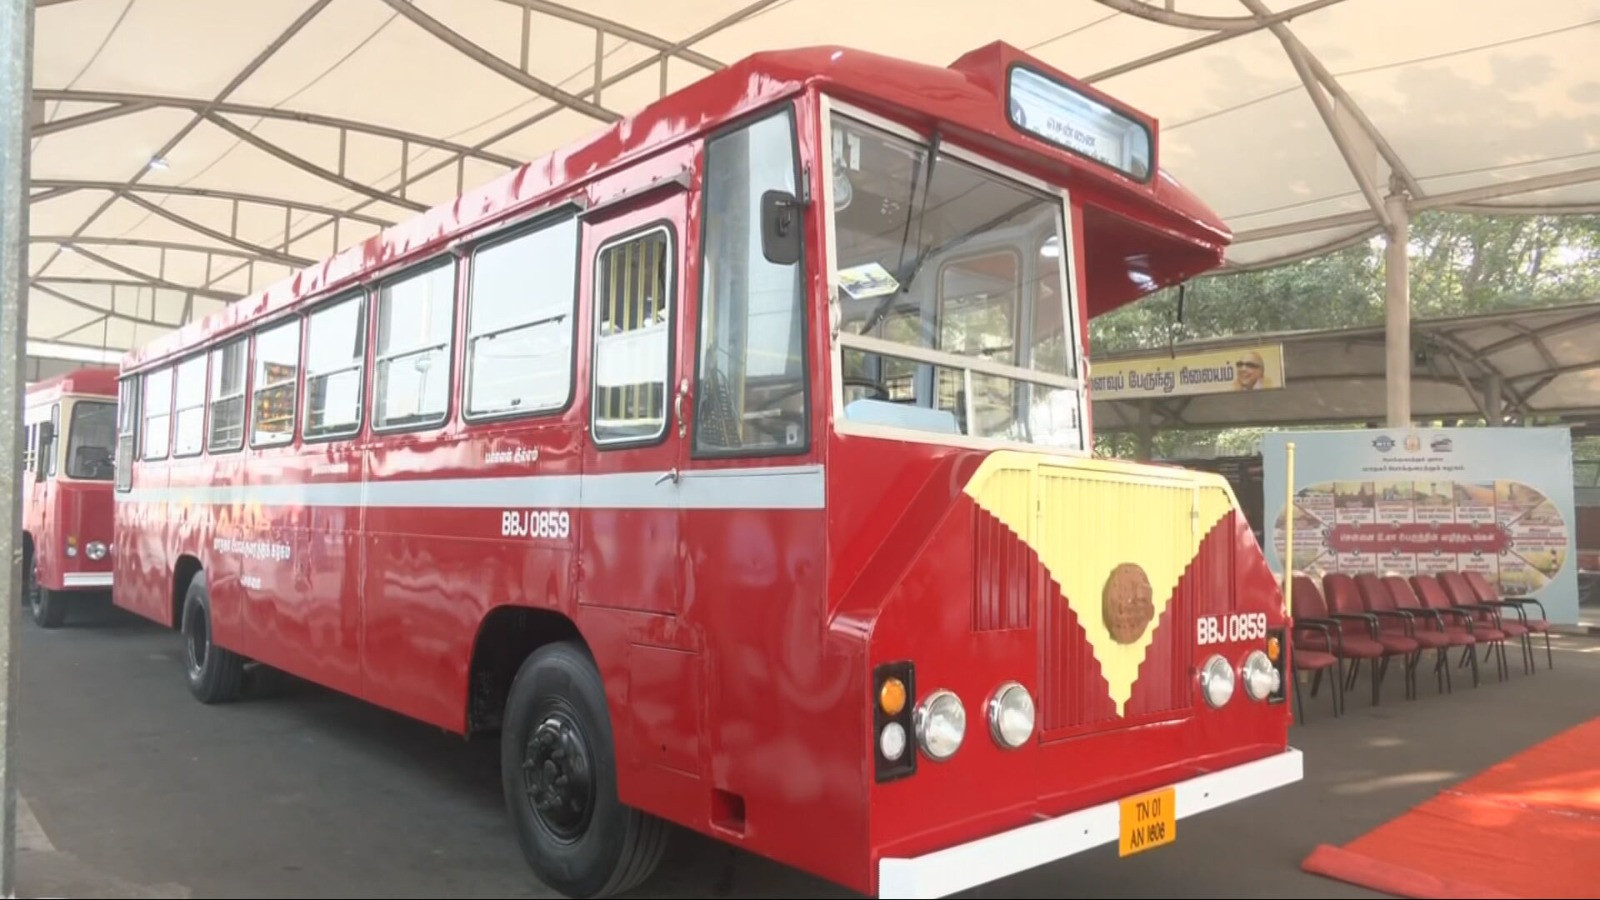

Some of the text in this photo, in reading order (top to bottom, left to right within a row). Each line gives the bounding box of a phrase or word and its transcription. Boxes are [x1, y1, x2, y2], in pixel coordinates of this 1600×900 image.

[1129, 367, 1175, 393] பேருந்து
[1180, 361, 1233, 384] நிலையம்
[502, 510, 570, 538] BBJ 0859
[1197, 612, 1267, 645] BBJ 0859
[1136, 797, 1161, 822] TN 01
[1130, 826, 1144, 849] AN
